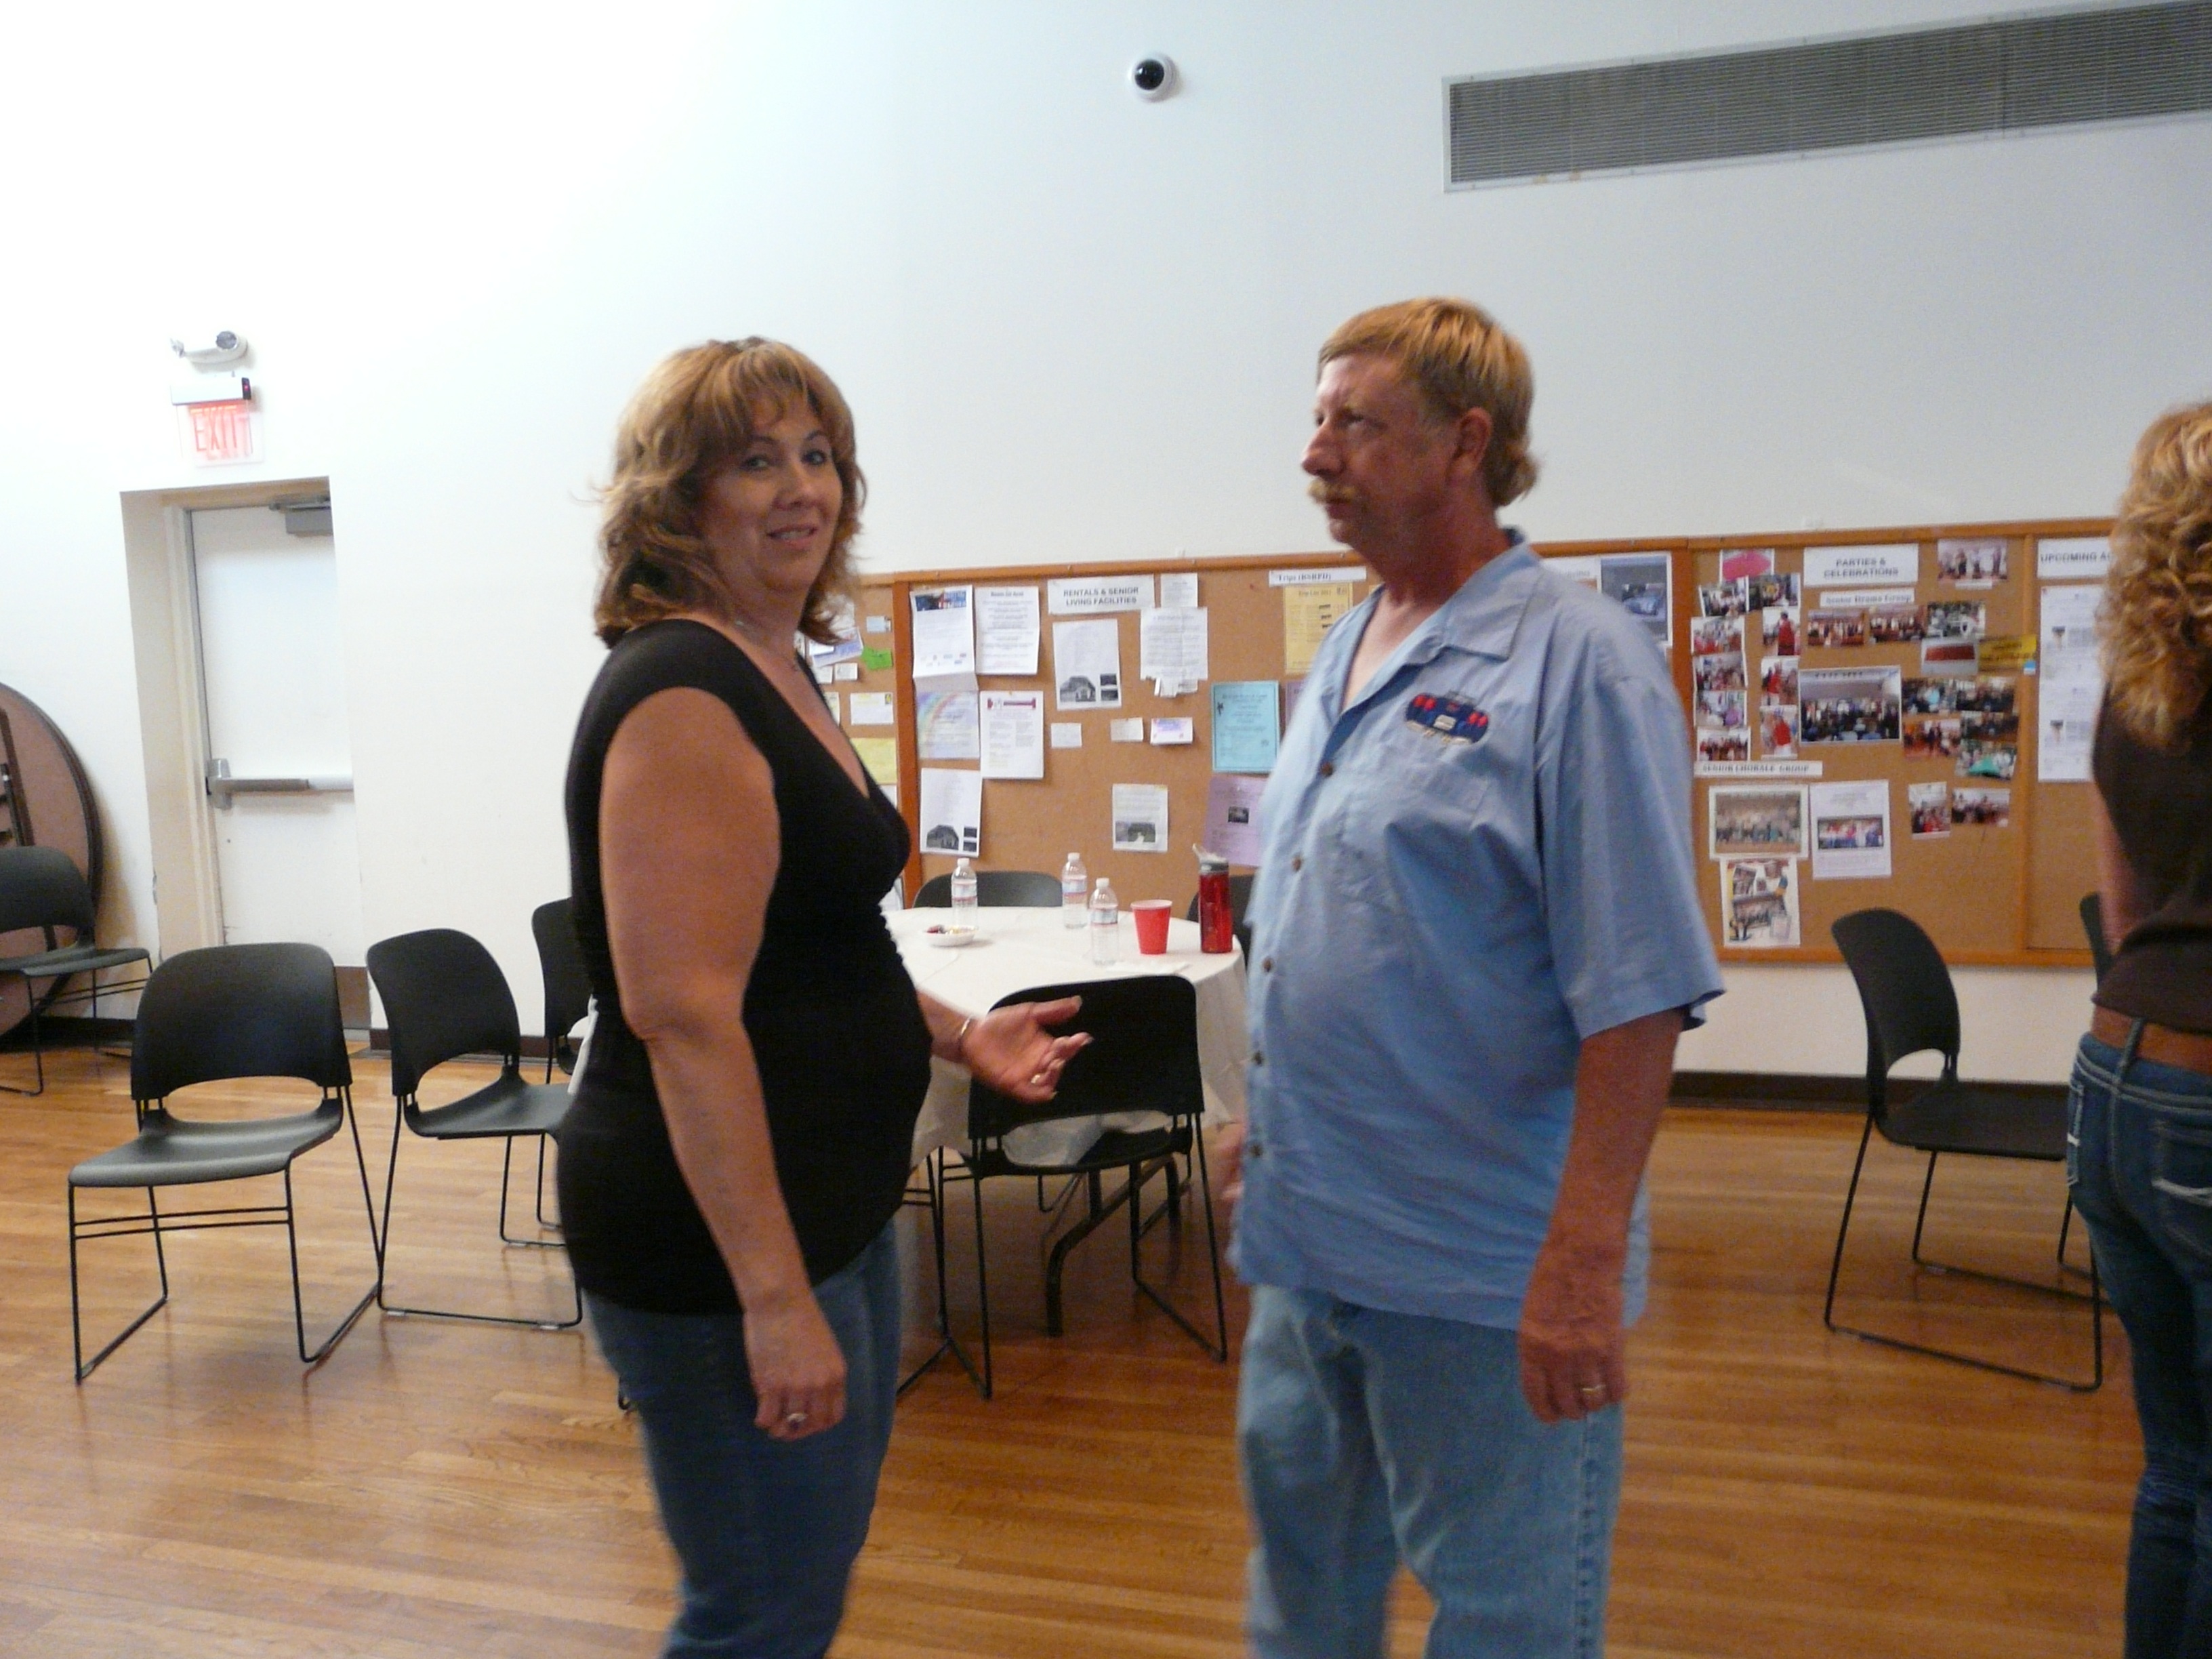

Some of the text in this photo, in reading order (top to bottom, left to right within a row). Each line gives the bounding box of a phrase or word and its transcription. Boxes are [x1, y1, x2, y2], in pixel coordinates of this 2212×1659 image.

[190, 407, 253, 453] EXIT
[1836, 557, 1886, 567] PARTIES &
[2040, 552, 2097, 563] UPCOMING
[1824, 568, 1899, 579] CELEBRATIONS
[1063, 588, 1099, 597] RENTALS
[1094, 596, 1136, 605] FACILITIES
